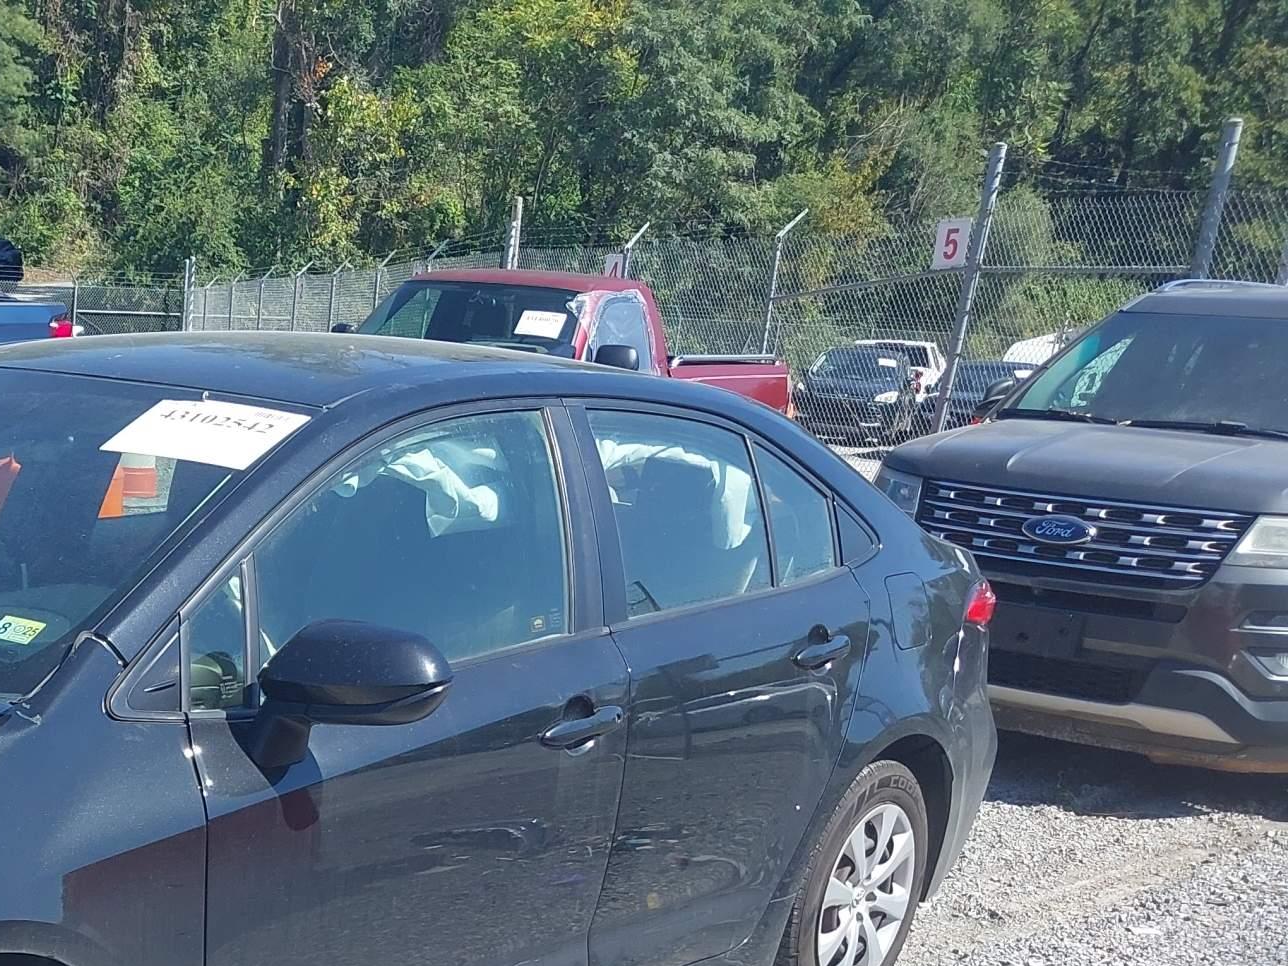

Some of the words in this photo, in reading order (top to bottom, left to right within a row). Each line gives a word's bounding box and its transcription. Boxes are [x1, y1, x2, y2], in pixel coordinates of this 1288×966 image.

[943, 228, 960, 260] 5
[160, 409, 275, 434] 43102542
[1035, 519, 1074, 538] Ford
[22, 626, 40, 637] 25
